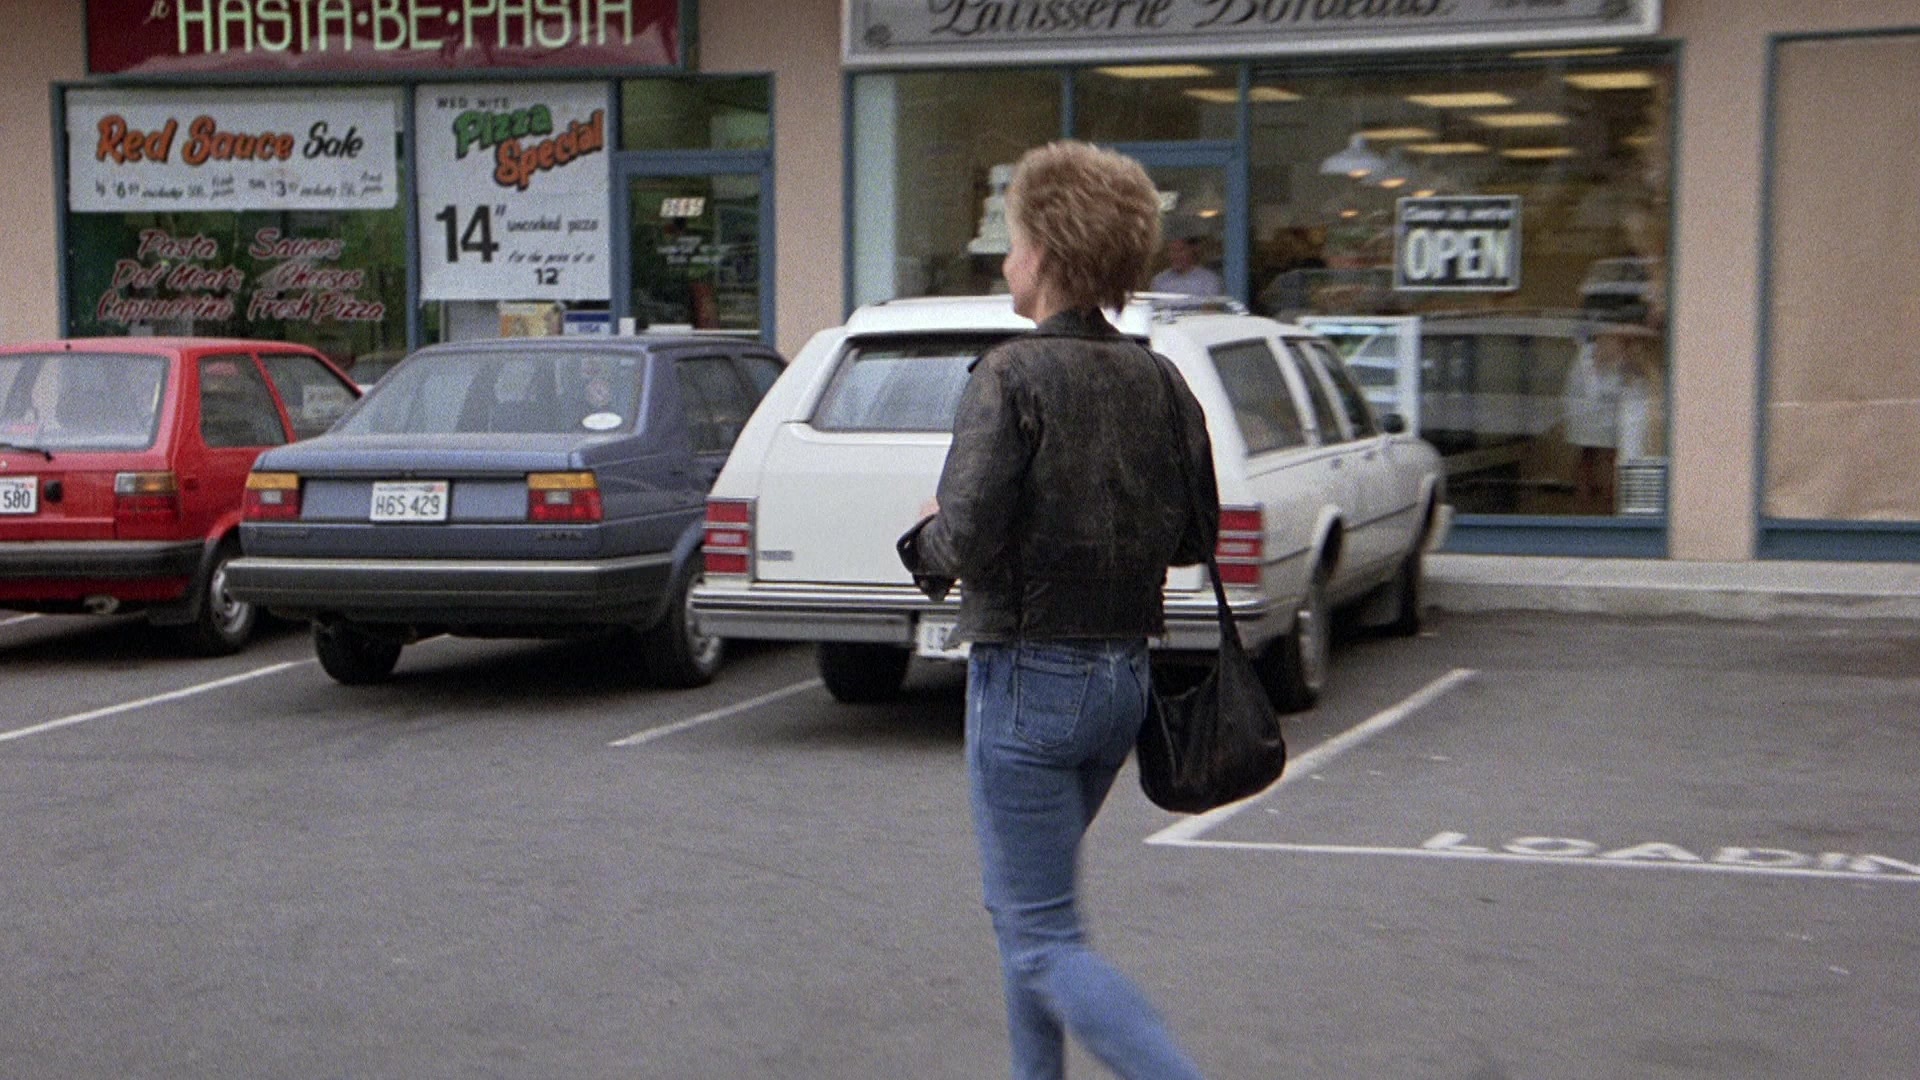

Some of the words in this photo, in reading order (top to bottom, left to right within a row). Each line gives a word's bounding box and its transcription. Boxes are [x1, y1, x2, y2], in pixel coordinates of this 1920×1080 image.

[96, 114, 179, 165] Red
[182, 114, 295, 167] Sauce
[303, 120, 364, 159] Sale
[453, 104, 553, 160] Pizza
[494, 109, 605, 192] Special
[137, 229, 219, 262] Pasta
[1405, 227, 1512, 280] OPEN
[3, 489, 32, 509] 580
[410, 494, 440, 516] 429
